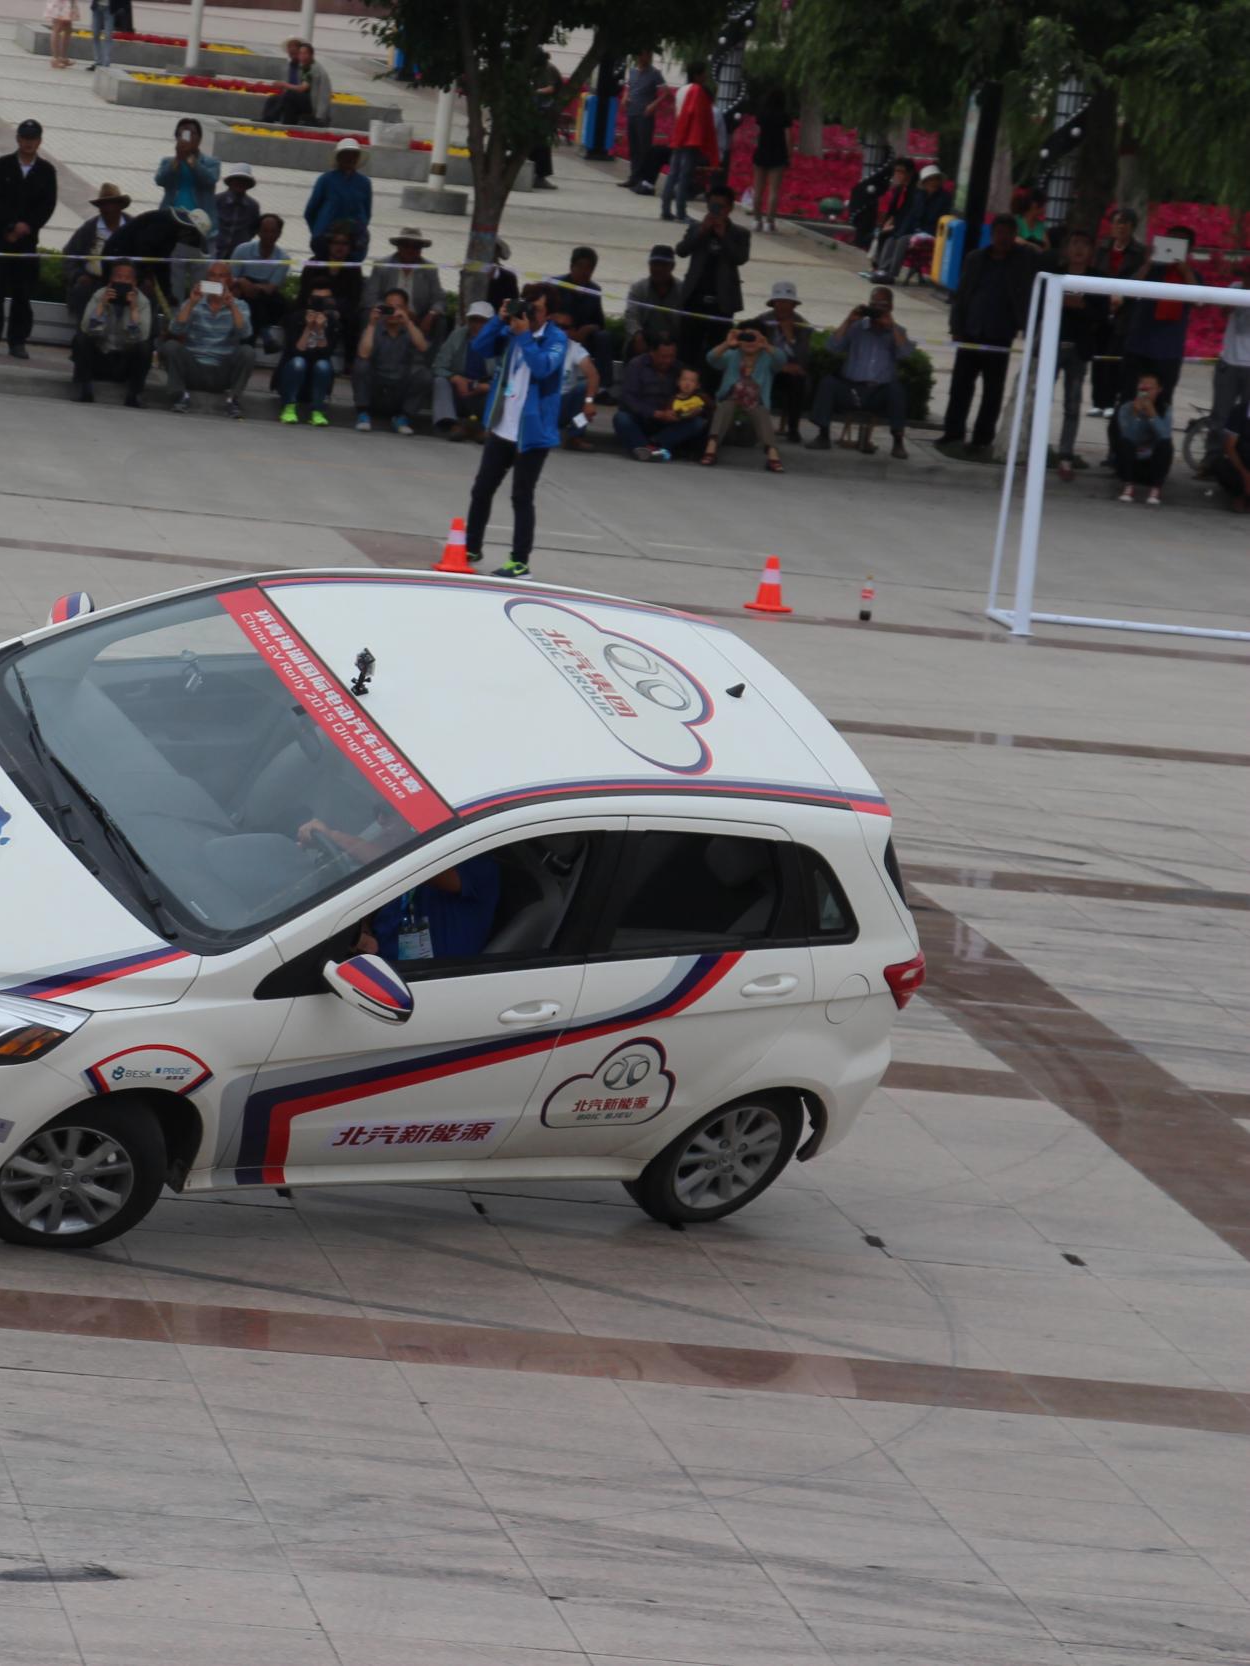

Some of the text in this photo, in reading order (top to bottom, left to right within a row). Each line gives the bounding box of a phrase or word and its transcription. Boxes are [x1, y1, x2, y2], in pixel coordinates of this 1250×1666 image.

[241, 612, 406, 799] China EV Rally 2015 Qinghai Lake
[526, 626, 615, 717] BAIC GROUP
[541, 627, 639, 718] 北汽集团
[332, 1122, 497, 1146] 北汽新能源
[571, 1096, 649, 1112] 北汽新能源
